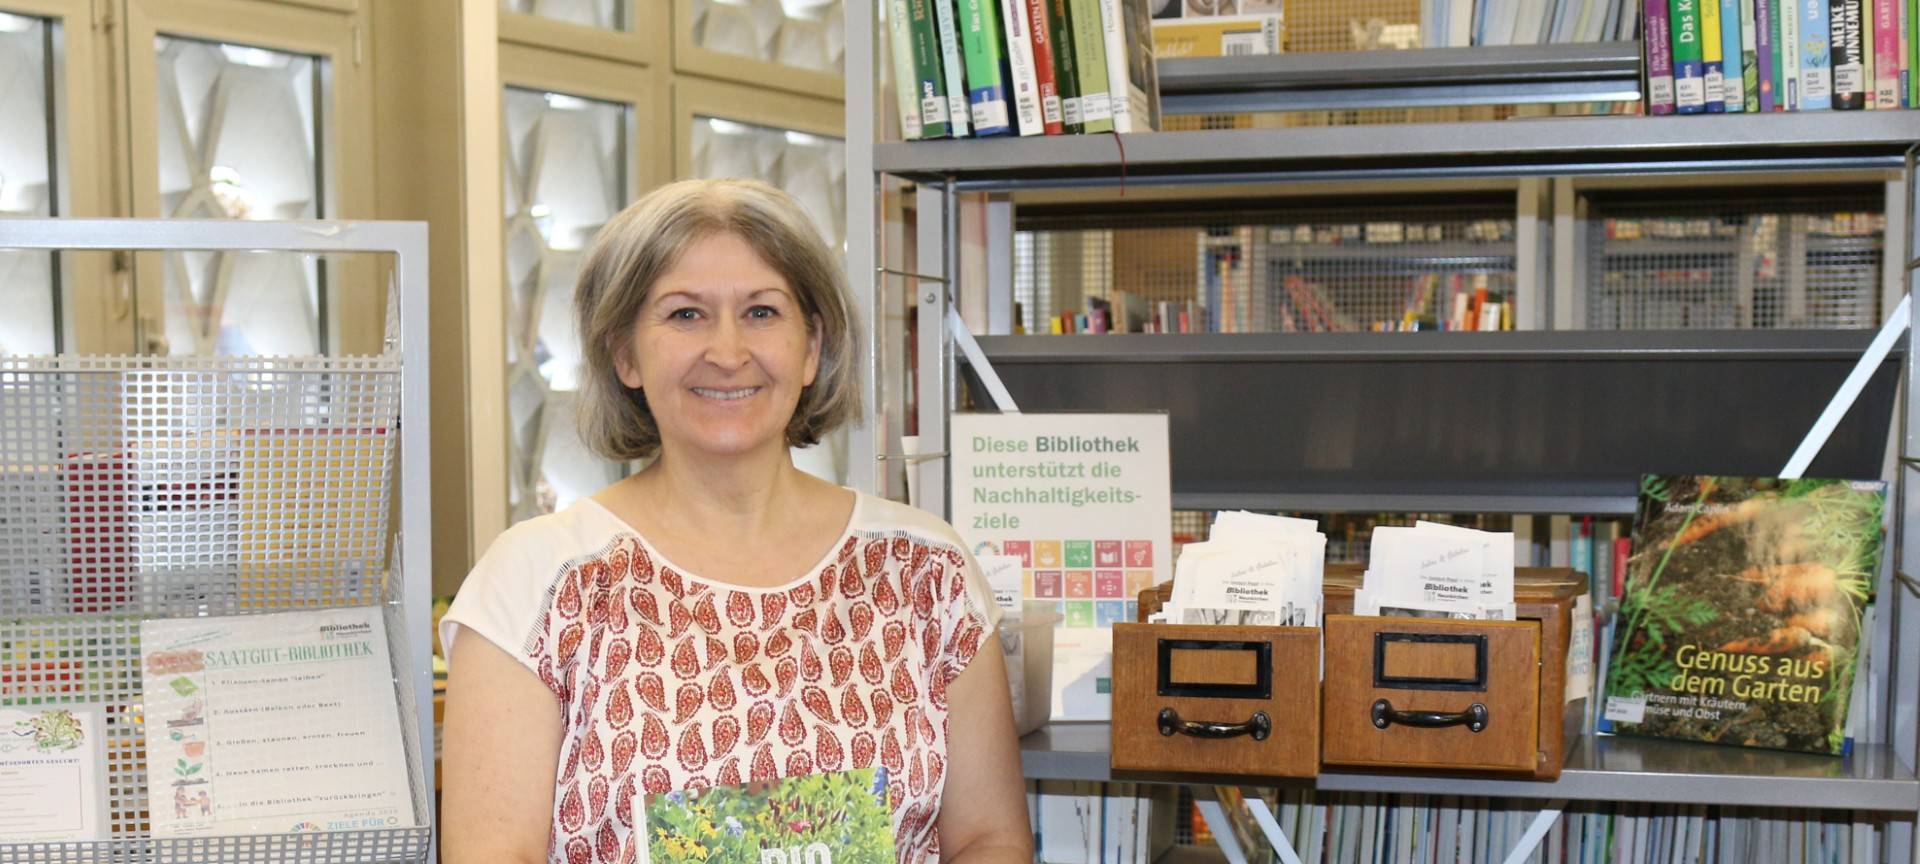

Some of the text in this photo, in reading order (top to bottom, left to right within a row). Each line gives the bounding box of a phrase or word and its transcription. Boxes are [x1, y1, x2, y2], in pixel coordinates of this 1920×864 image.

[1032, 7, 1044, 43] GARTEN
[1680, 15, 1694, 43] Das
[1831, 5, 1843, 47] MEIKE
[972, 436, 1140, 453] Diese Bibliothek
[973, 461, 1122, 478] unterstützt die
[973, 486, 1142, 507] Nachhaltigkeits-
[1664, 502, 1730, 515] Adam Caplin
[973, 512, 1020, 529] ziele
[1226, 587, 1268, 596] Bibliothek
[1424, 583, 1468, 593] Bibliothek
[320, 622, 371, 633] Bibliothek
[204, 641, 374, 667] SAATGUT-BIBLIOTHEK
[1676, 644, 1825, 680] Genuss aus
[1671, 668, 1821, 704] dem Garten
[1679, 695, 1697, 706] mit
[1700, 696, 1748, 711] Kräutern,
[1645, 707, 1672, 719] müse
[1674, 708, 1693, 719] und
[1695, 709, 1720, 720] Obst
[266, 796, 313, 806] Bibliothek
[327, 816, 385, 831] ZIELE FÜR
